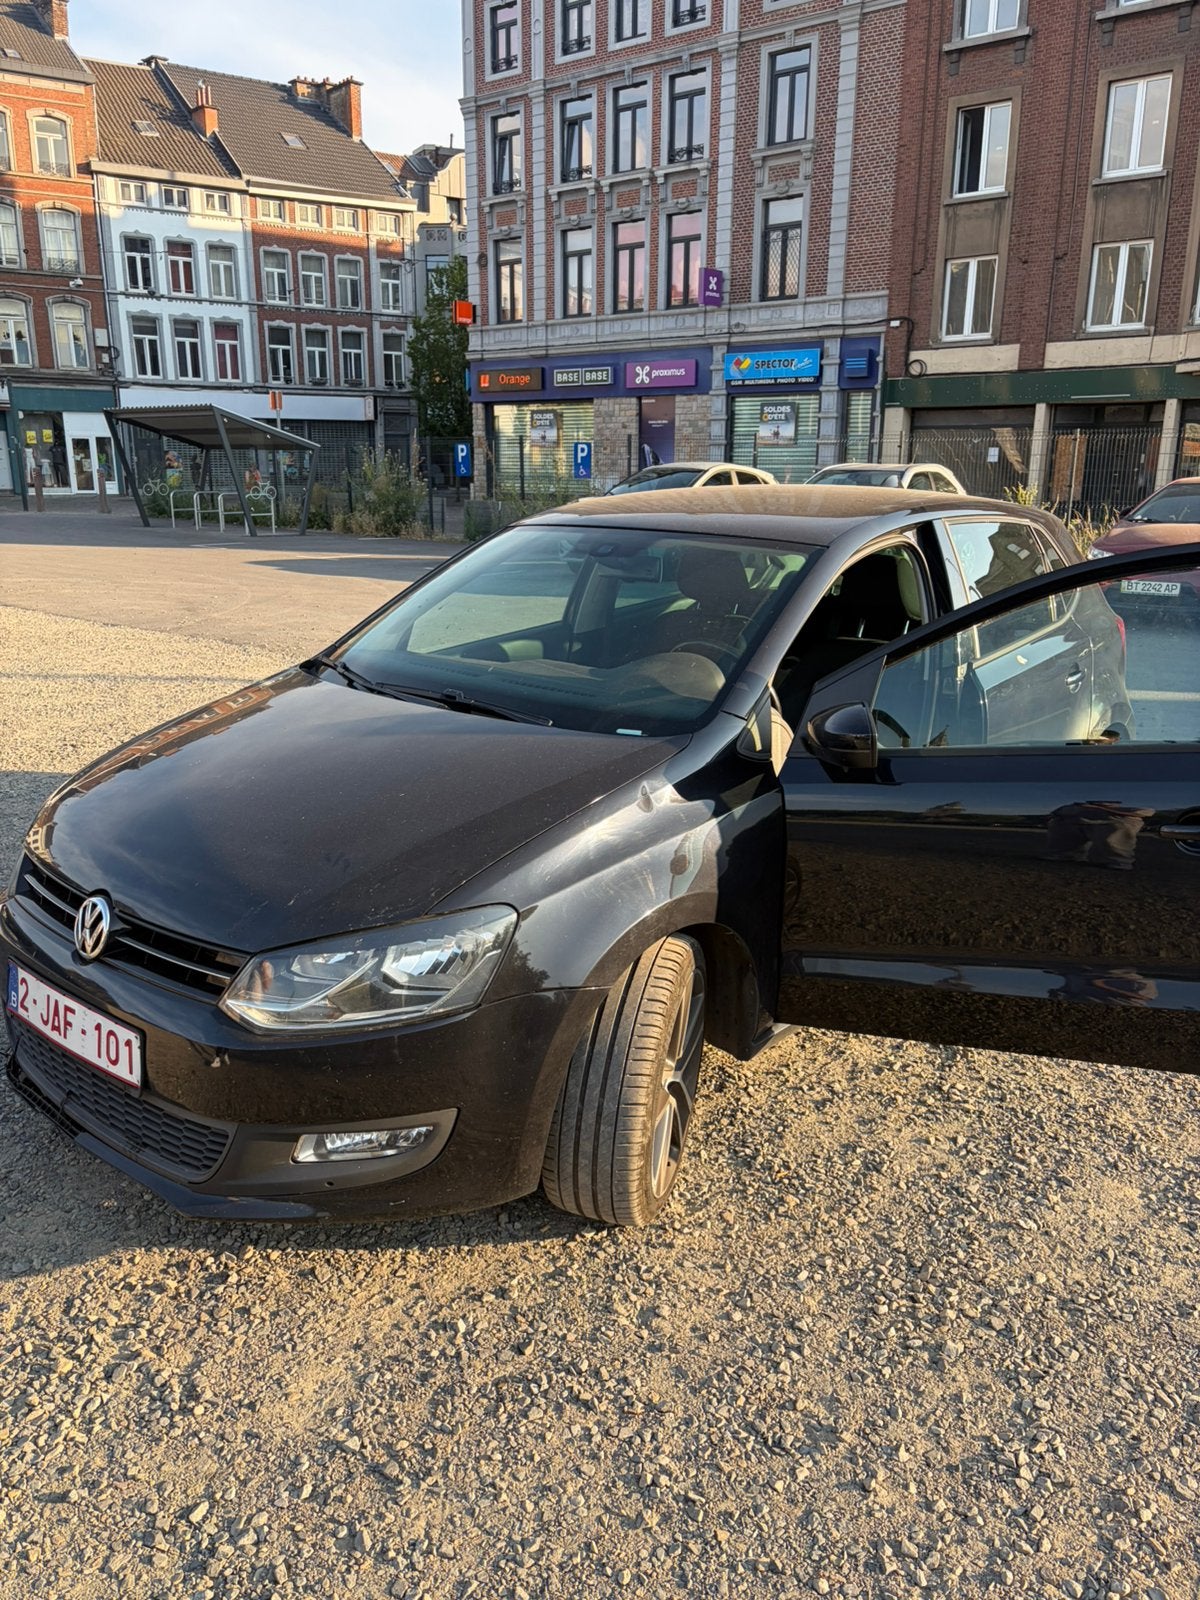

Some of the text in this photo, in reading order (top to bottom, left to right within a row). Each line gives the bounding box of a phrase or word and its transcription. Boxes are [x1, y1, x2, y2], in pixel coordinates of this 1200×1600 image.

[499, 373, 531, 386] Orange
[556, 372, 579, 383] BASE
[585, 371, 608, 381] BASE
[651, 368, 686, 379] proximus
[457, 444, 467, 463] P
[577, 443, 588, 464] P
[1126, 581, 1178, 593] BT 2242 AP
[10, 991, 18, 1008] B
